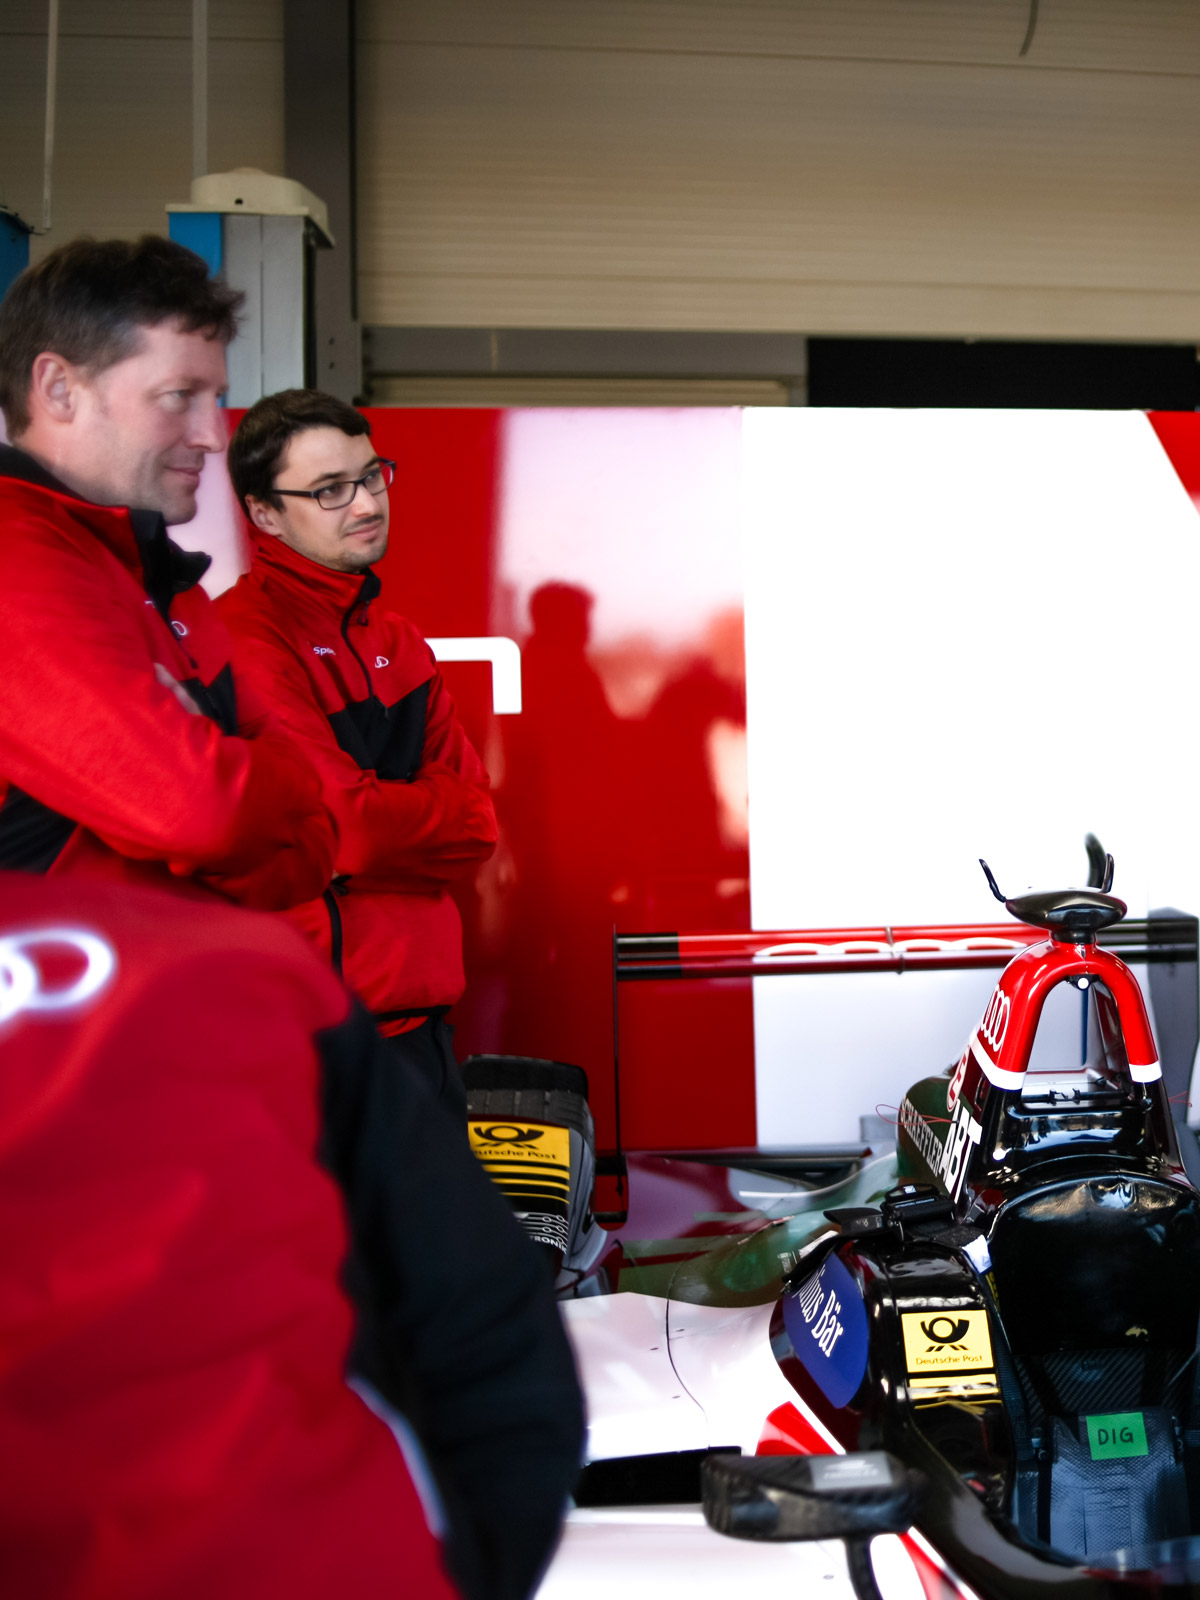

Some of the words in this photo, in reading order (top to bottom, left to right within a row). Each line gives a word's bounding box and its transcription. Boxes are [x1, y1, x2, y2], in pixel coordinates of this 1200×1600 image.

[474, 1149, 524, 1158] eutsche
[527, 1151, 557, 1160] Post
[938, 1098, 983, 1205] ABT
[811, 1289, 844, 1358] Bär
[915, 1355, 961, 1366] Deutsche
[962, 1354, 983, 1363] Post
[1097, 1426, 1134, 1446] DIG
